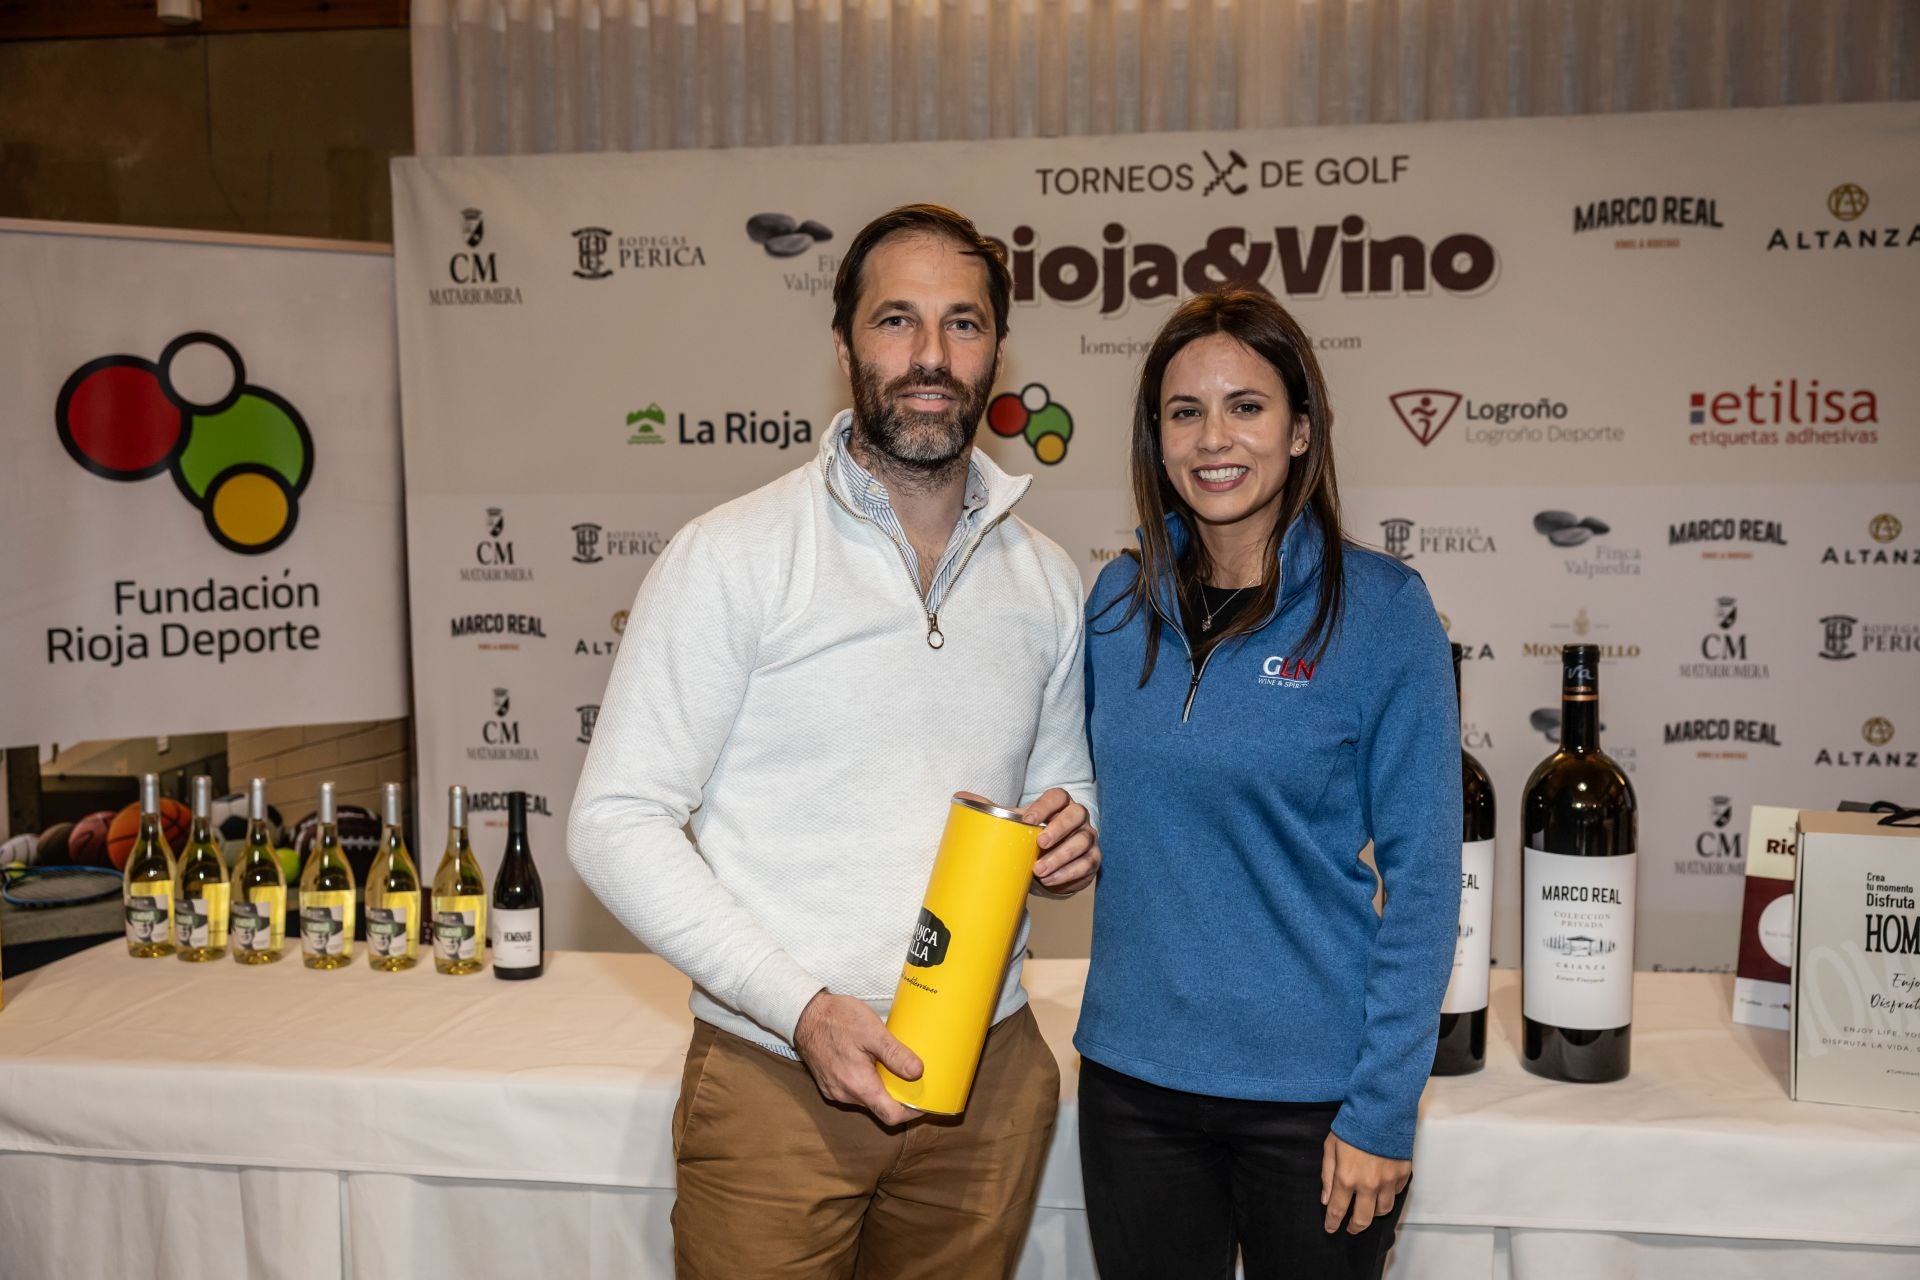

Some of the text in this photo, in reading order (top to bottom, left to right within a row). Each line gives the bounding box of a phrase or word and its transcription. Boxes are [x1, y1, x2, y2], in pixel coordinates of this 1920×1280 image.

[1035, 154, 1411, 196] TORNEOS DE GOLF
[1573, 196, 1725, 234] MARCO REAL
[617, 236, 687, 248] BODEGAS
[1766, 223, 1920, 251] ALTANZA
[449, 252, 498, 284] CM
[618, 247, 707, 269] PERICA
[818, 254, 841, 272] Fi
[984, 212, 1500, 316] ioja&Vino
[1465, 397, 1568, 425] Logroño
[1710, 379, 1879, 426] etilisa
[678, 410, 812, 451] La Rioja
[1465, 424, 1625, 446] Logroño Deporte
[1689, 426, 1879, 449] etiquetas adhesivas
[1419, 535, 1497, 554] PERICA
[1668, 518, 1788, 546] MARCO REAL
[476, 540, 515, 566] CM
[114, 568, 320, 616] Fundación
[450, 613, 547, 638] MARCO REAL
[46, 620, 321, 668] Rioja Deporte
[1700, 633, 1748, 662] CM
[1262, 655, 1316, 681] GLN
[1258, 677, 1276, 687] WINE
[482, 720, 520, 745] CM
[1663, 719, 1782, 747] MARCO REAL
[1813, 748, 1920, 768] ALTANZ
[467, 791, 553, 817] ARCO EAL
[1695, 830, 1742, 859] CM
[1461, 873, 1480, 890] EAL
[1866, 871, 1886, 883] Crea
[1866, 882, 1914, 894] tu momento
[1541, 885, 1623, 905] MARCO REAL
[1865, 892, 1916, 909] Disfruta
[1865, 913, 1920, 956] HOM
[1891, 972, 1920, 995] Enjo
[1870, 992, 1920, 1014] Disfrut
